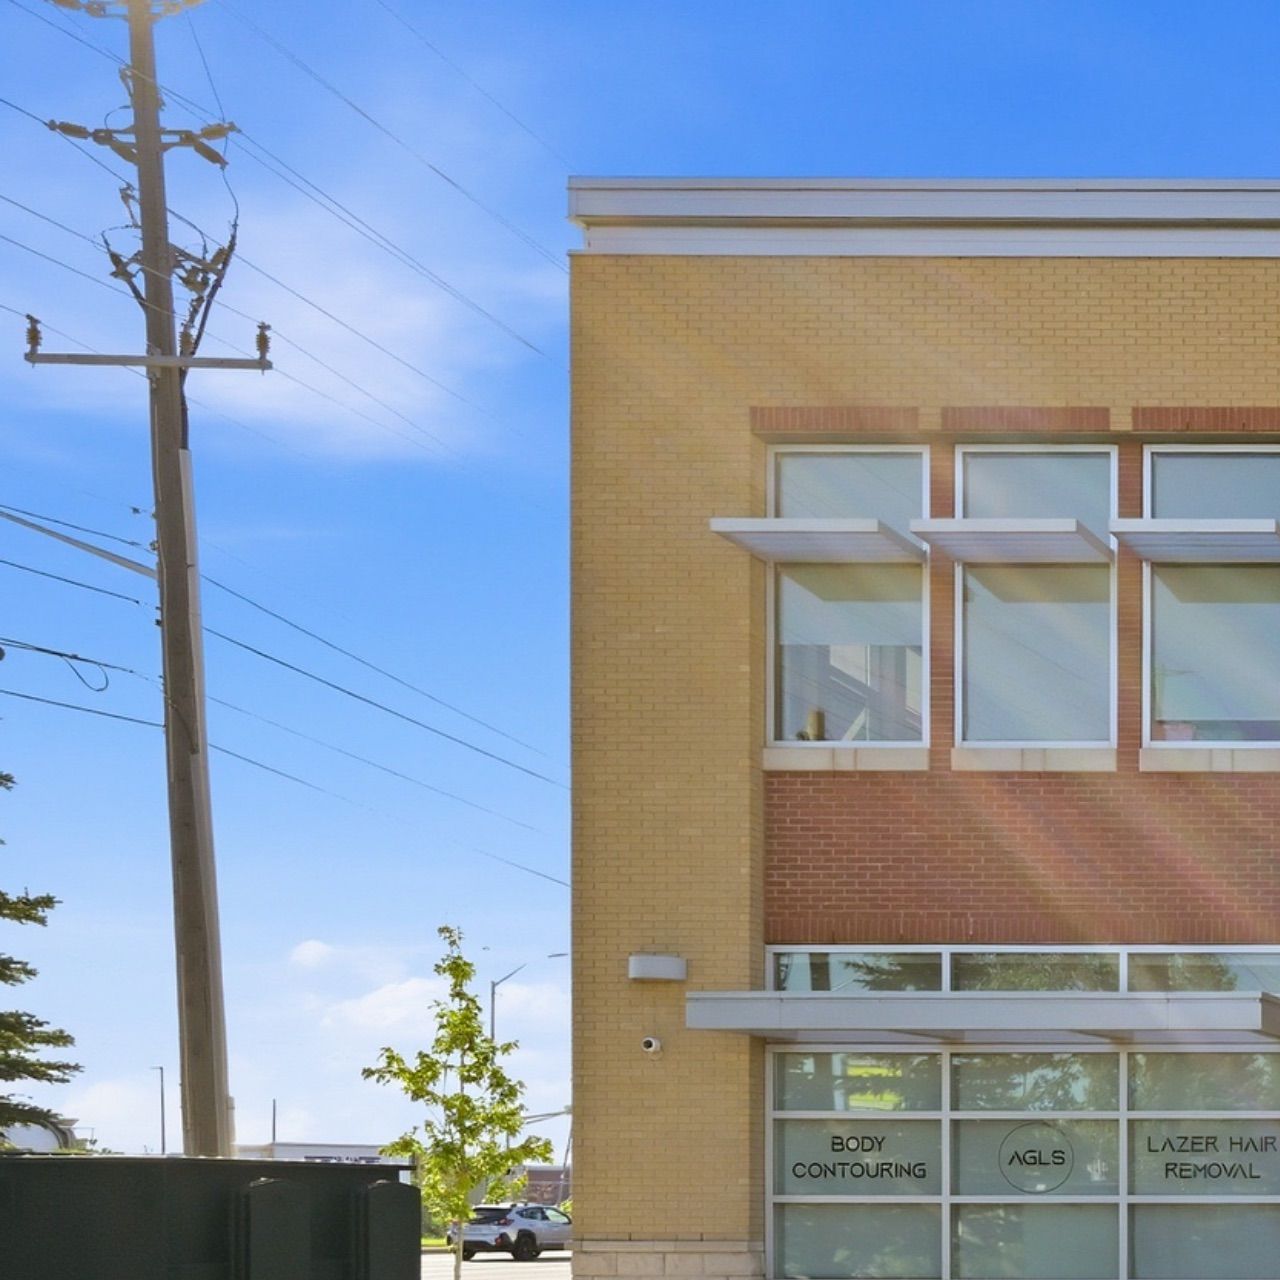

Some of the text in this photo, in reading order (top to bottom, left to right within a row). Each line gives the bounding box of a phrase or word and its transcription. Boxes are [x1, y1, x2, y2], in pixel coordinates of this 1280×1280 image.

[830, 1136, 886, 1153] BODY
[1147, 1136, 1277, 1153] LAZER HAIR
[1008, 1150, 1066, 1166] AGLS
[792, 1162, 927, 1180] CONTOURING
[1165, 1162, 1261, 1180] REMOVAL
